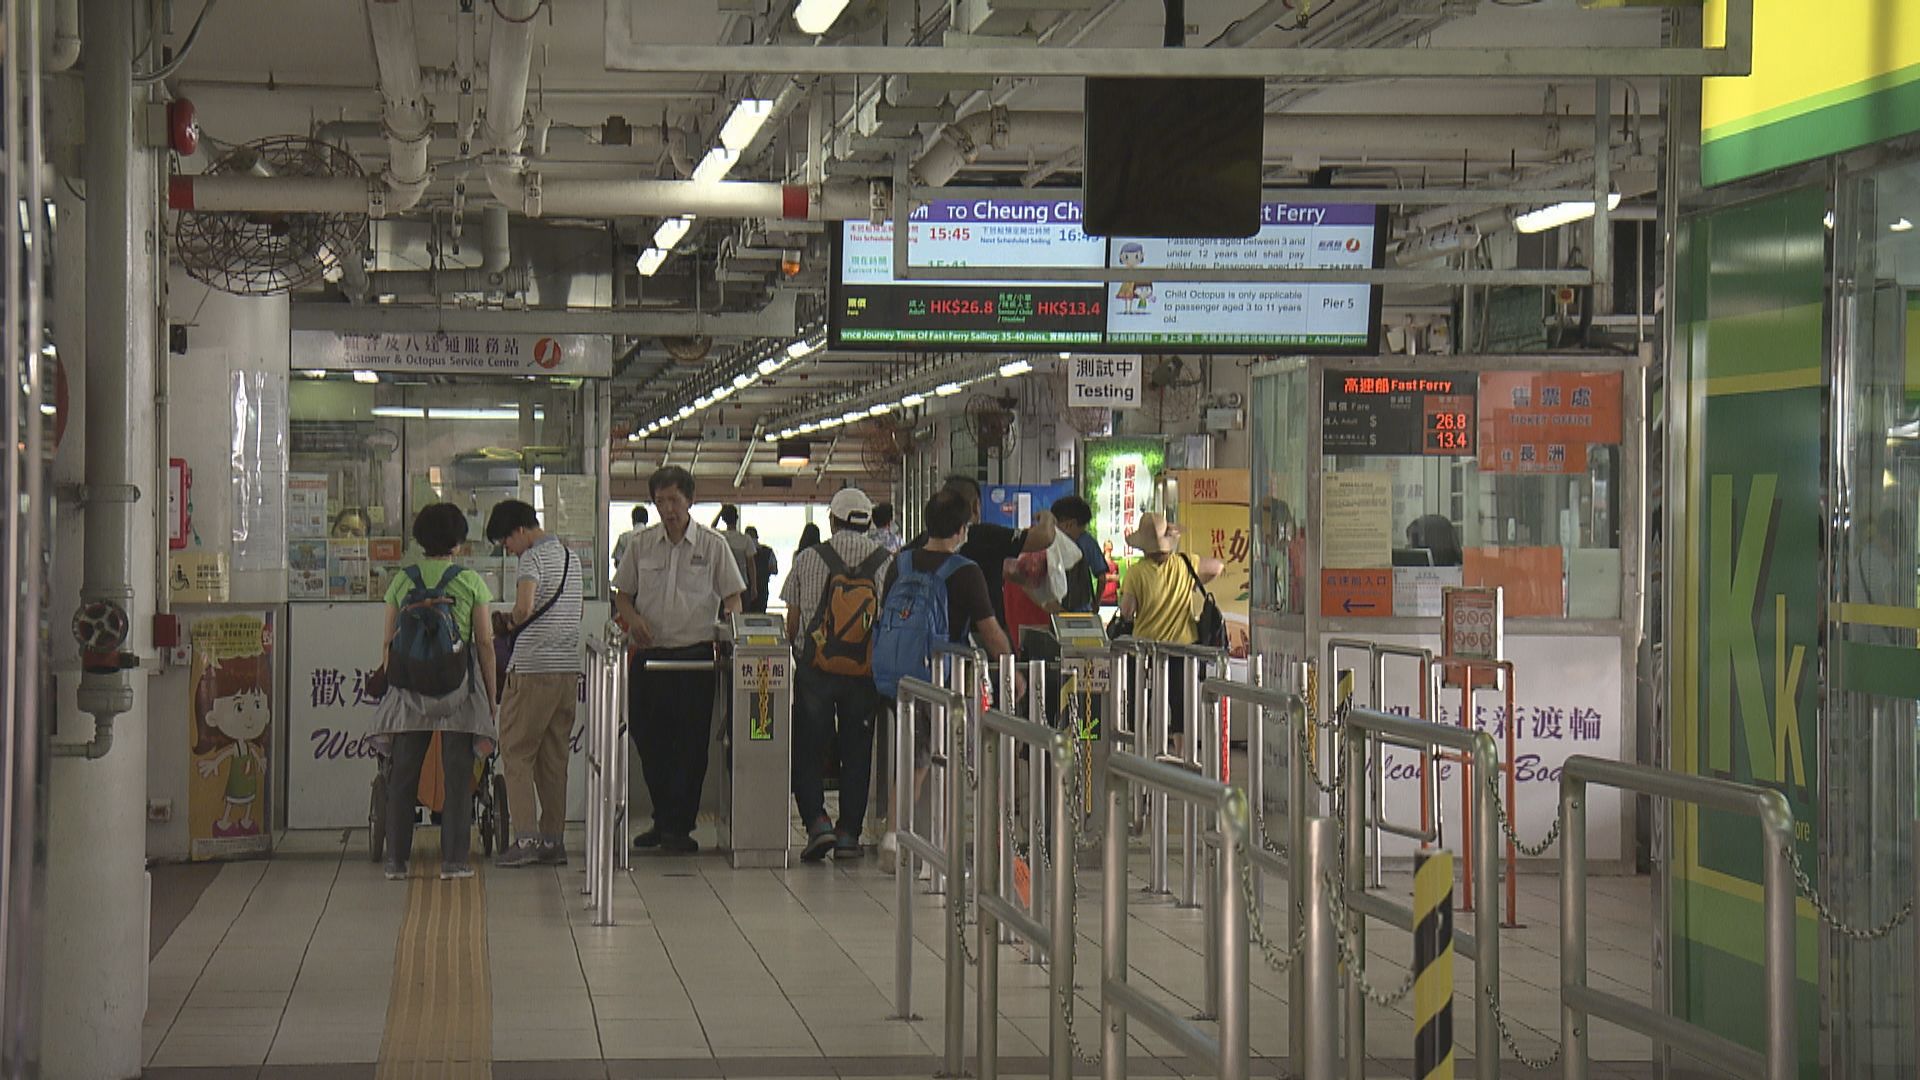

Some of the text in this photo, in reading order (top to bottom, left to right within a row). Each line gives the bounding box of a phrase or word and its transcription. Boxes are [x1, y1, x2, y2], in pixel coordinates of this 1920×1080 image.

[947, 205, 968, 220] TO
[973, 200, 1049, 224] Cheung
[1054, 201, 1083, 220] Ch
[1277, 203, 1326, 225] Ferry
[929, 227, 970, 241] 15:45
[1167, 237, 1306, 247] Passengers aged between 3 and
[1166, 249, 1305, 260] under 12 years old shall pay
[1164, 289, 1303, 302] Child Octopus is only applicable
[930, 298, 993, 315] HK$26.8
[1037, 300, 1101, 316] HK$13.4
[1163, 303, 1302, 314] to passenger aged 3 to 11 years
[1322, 297, 1354, 309] Pier 5
[862, 330, 894, 340] Journey
[896, 330, 916, 339] Time
[1001, 331, 1025, 341] 35-40
[1314, 335, 1340, 344] Actual
[344, 353, 519, 368] Customer & Octopus Service Centre
[1076, 358, 1133, 377] 測試中
[1075, 383, 1134, 401] Testing
[1391, 379, 1452, 393] Fast Ferry
[1351, 402, 1370, 411] Fare
[1369, 414, 1377, 428] $
[1435, 413, 1467, 430] 26.8
[1510, 414, 1592, 426] TICKET OFFICE
[1369, 433, 1377, 447] $
[1436, 431, 1467, 448] 13.4
